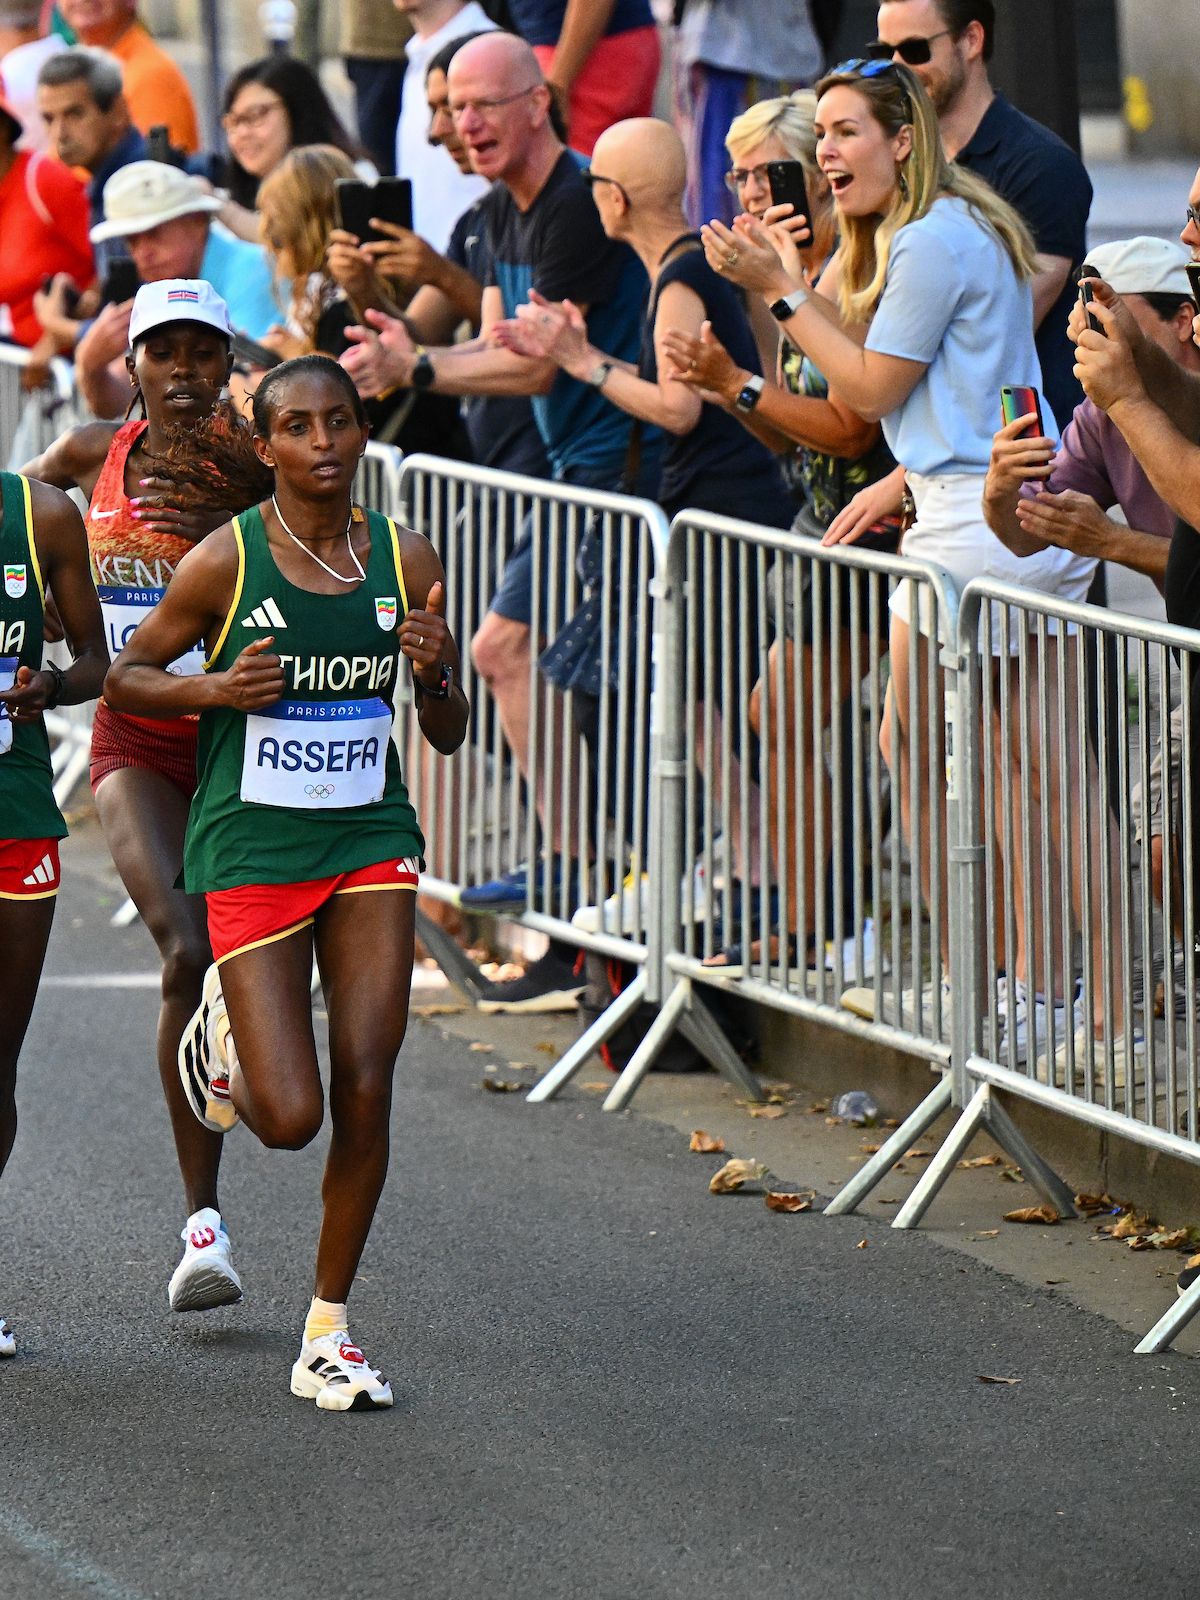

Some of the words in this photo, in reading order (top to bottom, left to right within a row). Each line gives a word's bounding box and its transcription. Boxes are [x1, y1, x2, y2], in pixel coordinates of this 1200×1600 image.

[258, 654, 394, 691] THIOPIA
[330, 706, 362, 717] 2024
[257, 736, 379, 773] ASSEFA
